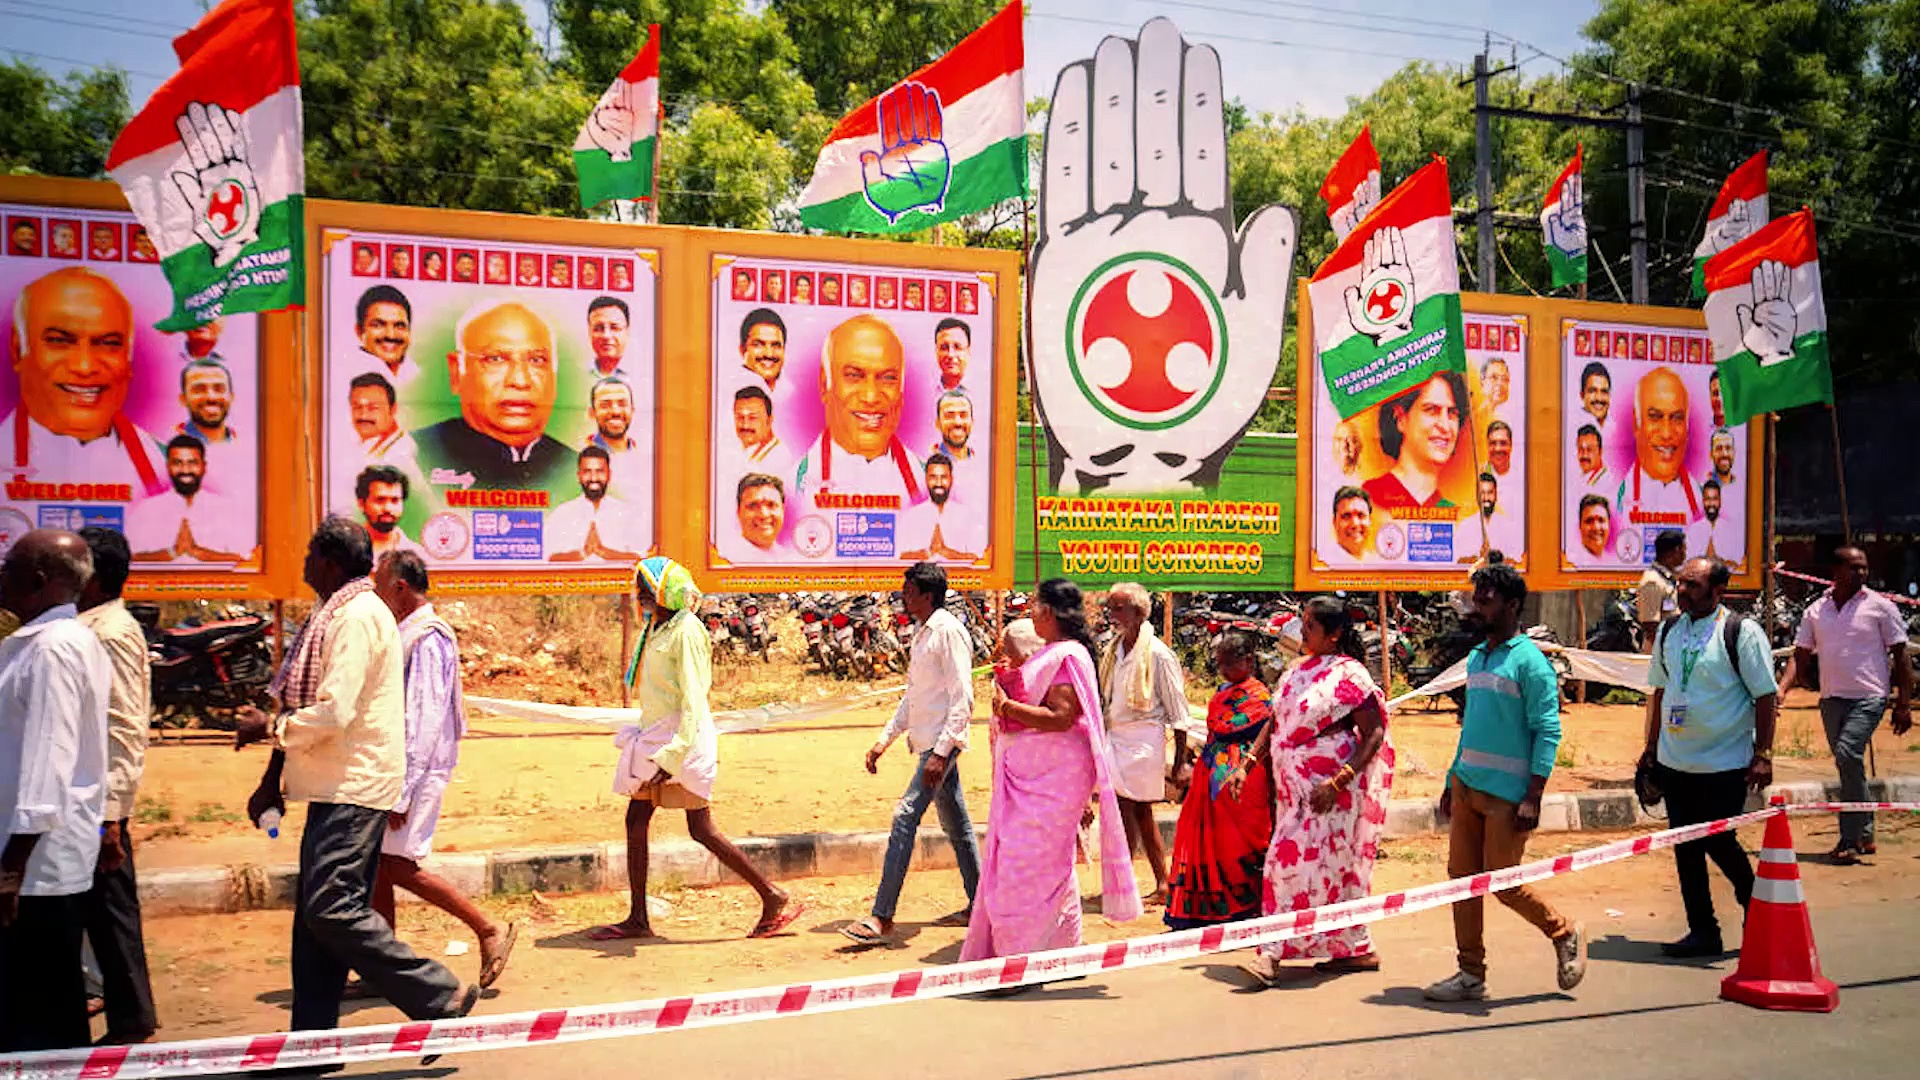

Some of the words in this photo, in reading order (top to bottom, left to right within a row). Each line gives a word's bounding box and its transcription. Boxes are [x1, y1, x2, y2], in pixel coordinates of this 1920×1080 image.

[4, 482, 132, 501] WELCOME
[446, 489, 550, 507] WELCOME
[814, 493, 902, 509] WELCOME
[1037, 496, 1178, 532] KARNATAKA
[1180, 499, 1281, 534] PRADESH
[1391, 506, 1459, 520] WELCOME
[1629, 511, 1687, 524] WELCOME
[1059, 540, 1142, 573] YOUTH
[1144, 541, 1263, 575] CONGRESS
